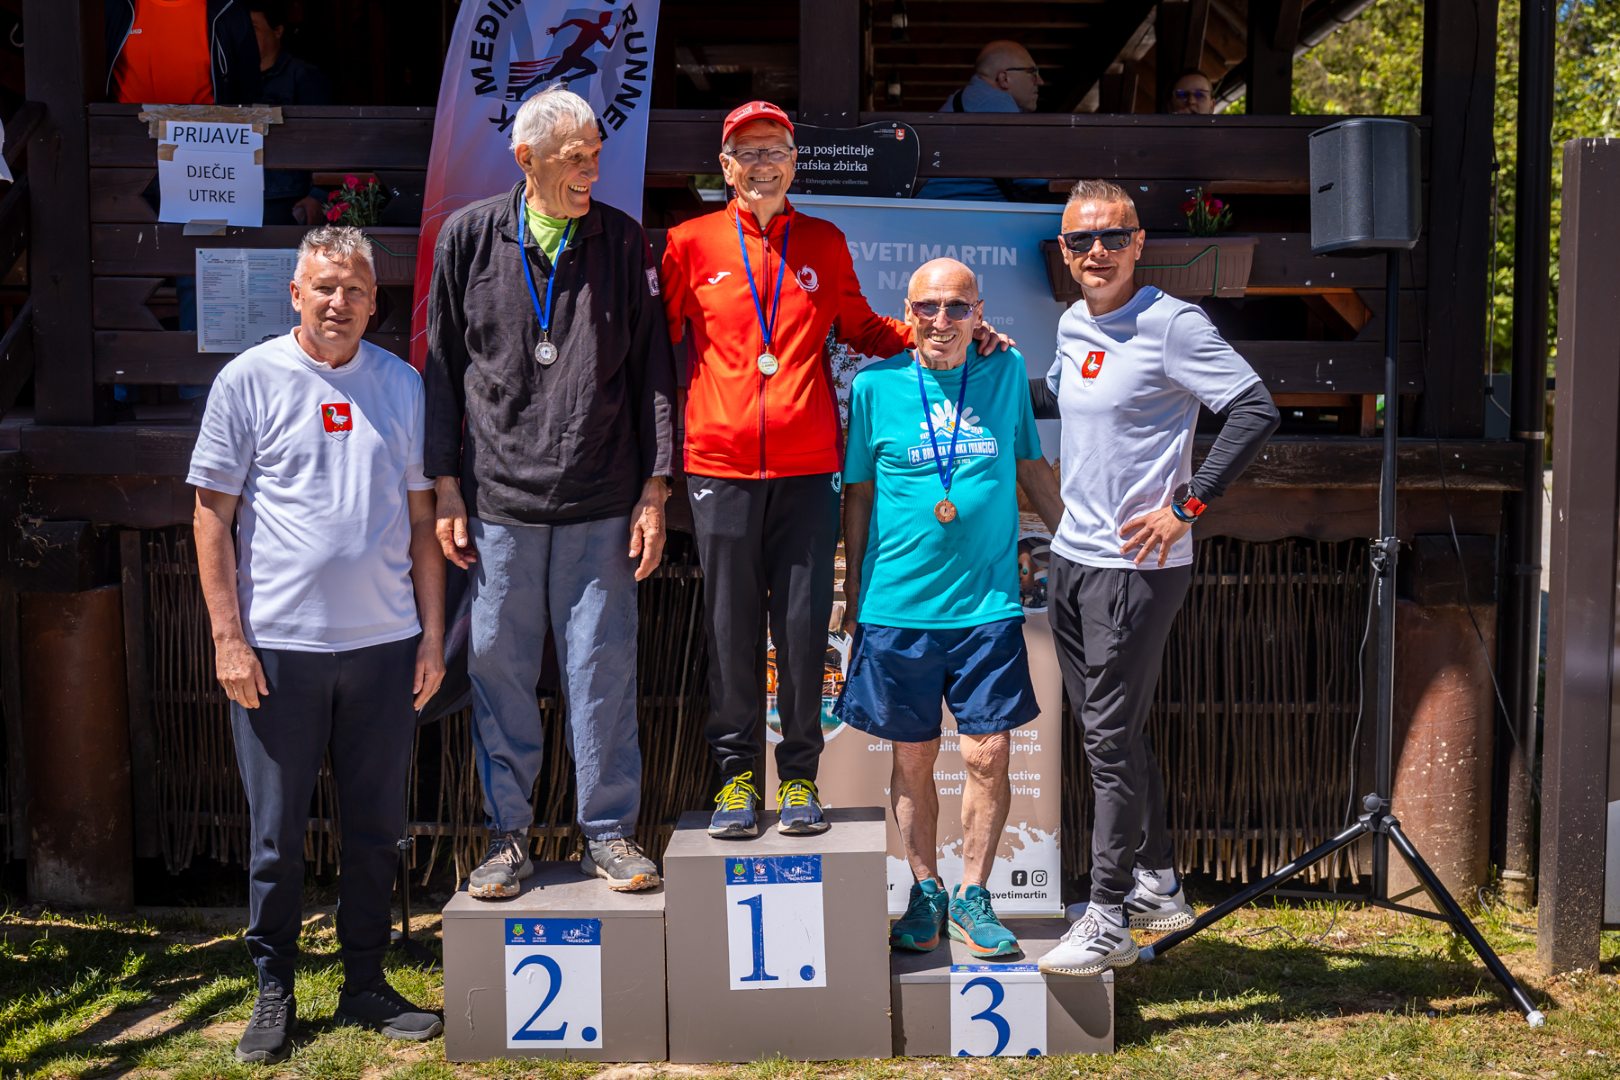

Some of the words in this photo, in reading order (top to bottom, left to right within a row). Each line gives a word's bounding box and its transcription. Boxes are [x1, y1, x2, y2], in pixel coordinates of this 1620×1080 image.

[173, 125, 250, 145] PRIJAVE
[798, 145, 811, 154] za
[813, 144, 875, 158] posjetitelje
[187, 163, 236, 180] DJEČJE
[794, 160, 831, 171] rafska
[833, 160, 868, 172] zbirka
[189, 189, 236, 204] UTRKE
[847, 241, 914, 263] SVETI
[919, 244, 1017, 266] MARTIN
[939, 784, 961, 796] and
[990, 890, 1048, 900] svetimartin
[737, 893, 816, 982] 1.
[511, 953, 598, 1042] 2.
[957, 976, 1042, 1058] 3.
